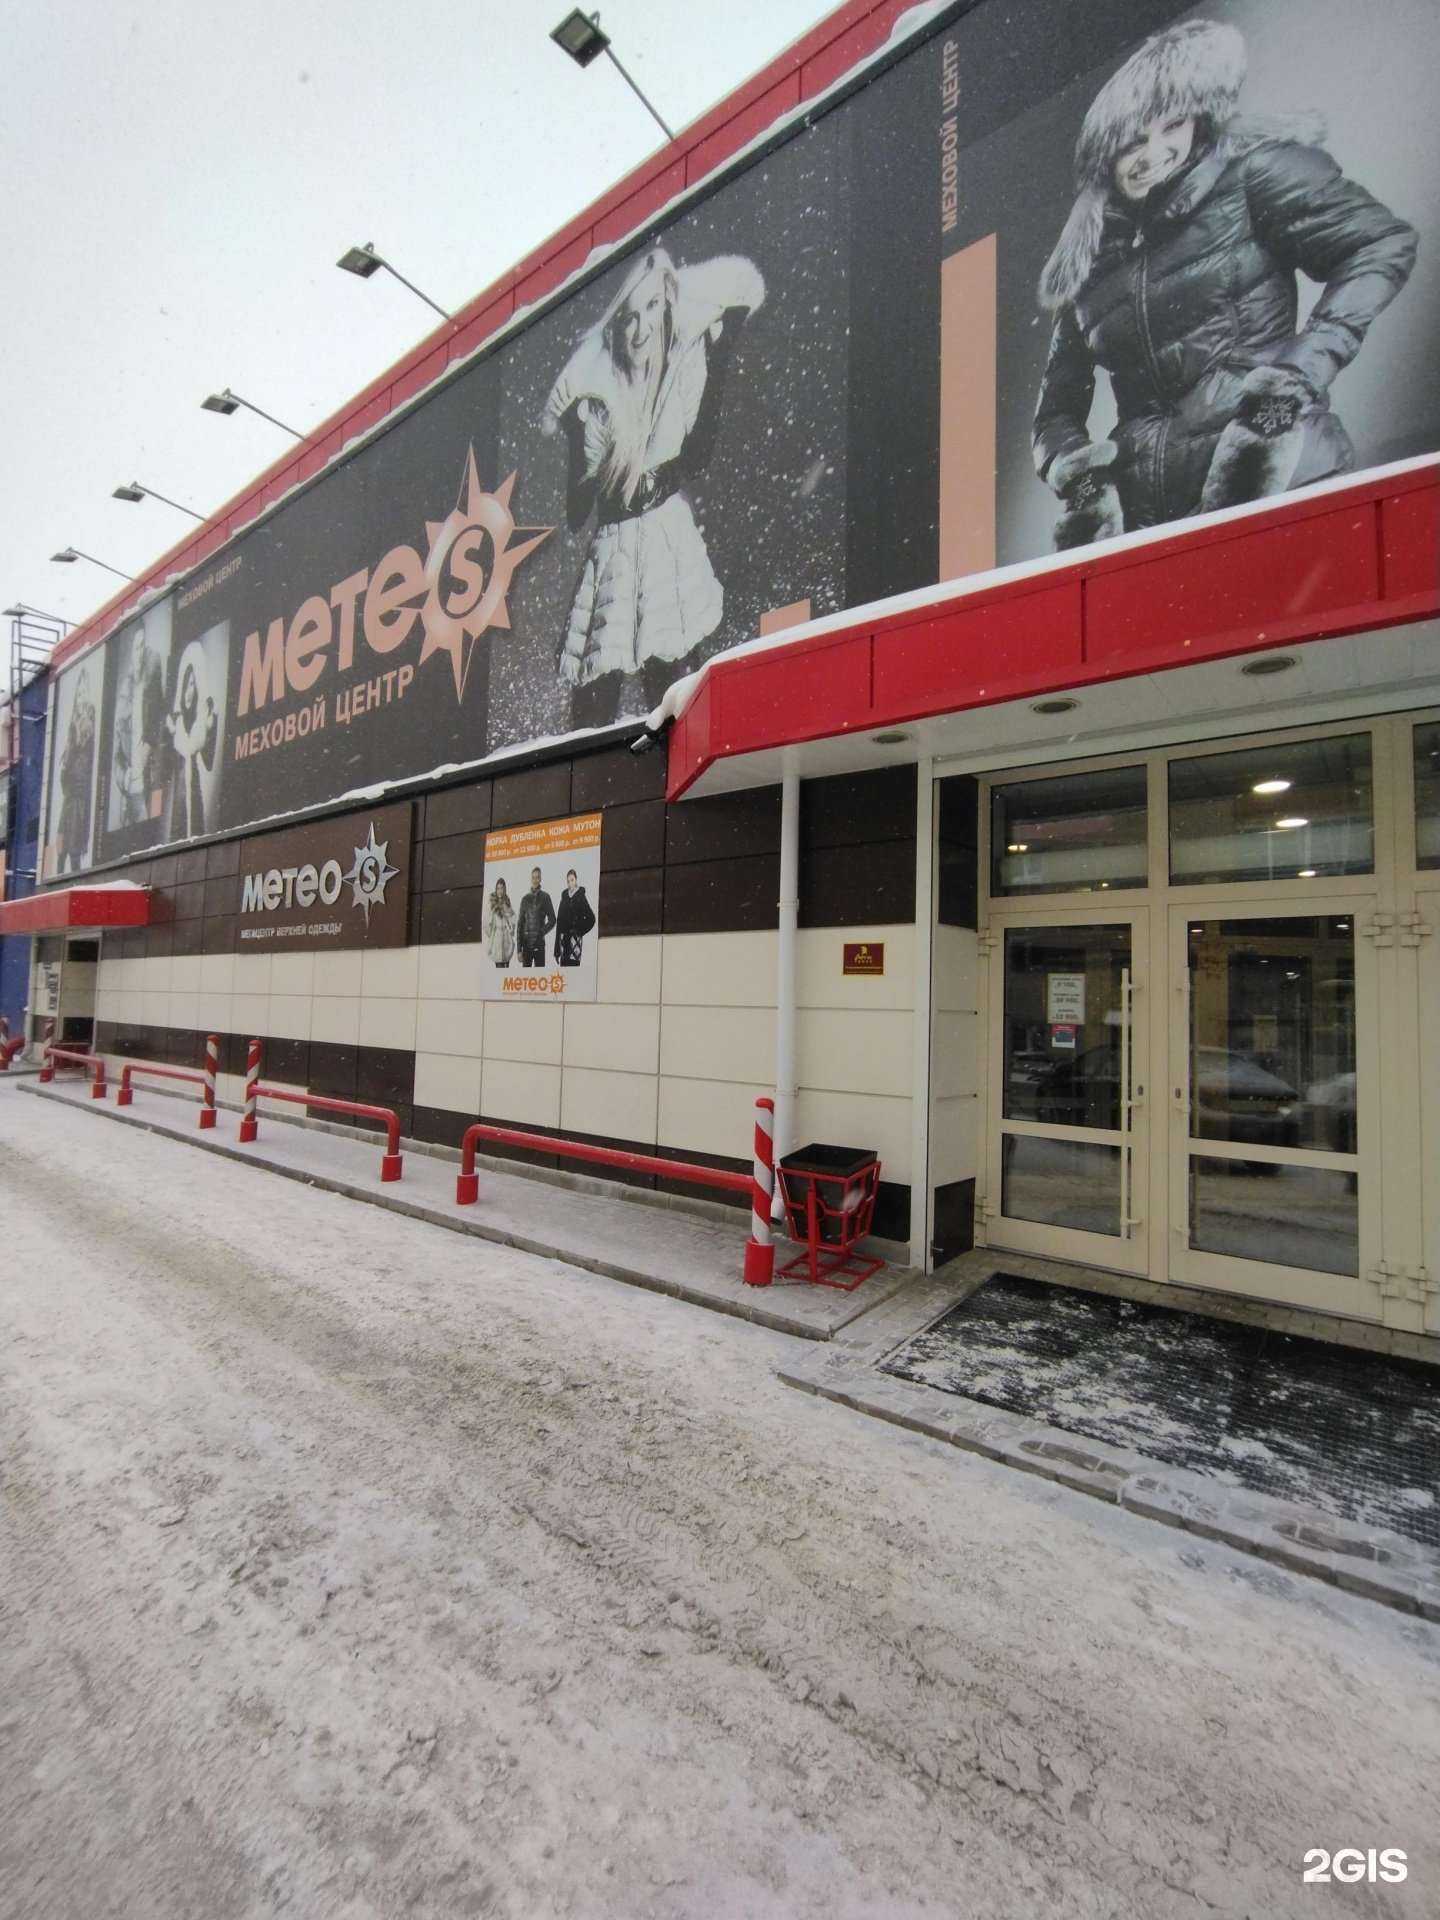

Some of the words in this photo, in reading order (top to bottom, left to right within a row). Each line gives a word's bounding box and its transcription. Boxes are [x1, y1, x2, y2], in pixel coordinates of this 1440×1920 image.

[942, 39, 960, 114] ЦЕНТР
[939, 116, 958, 232] МЕХОВОЙ
[235, 697, 326, 760] МЕХОВОЙ
[335, 664, 414, 725] ЦЕНТР
[549, 825, 570, 836] КОЖА
[573, 819, 601, 831] МУТОН
[276, 923, 307, 937] ВЕРХНЕЙ
[308, 922, 343, 937] ОДЕЖДЫ
